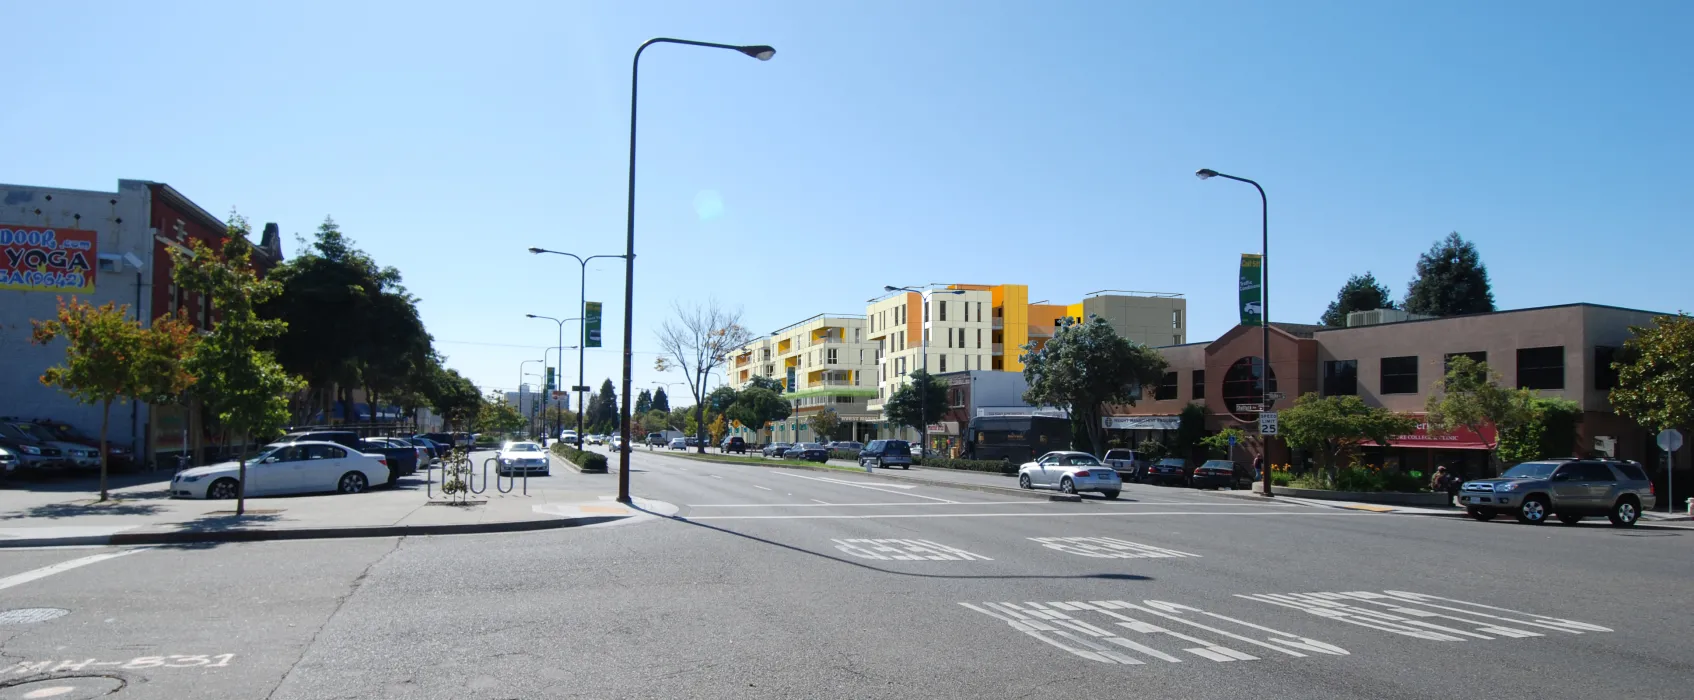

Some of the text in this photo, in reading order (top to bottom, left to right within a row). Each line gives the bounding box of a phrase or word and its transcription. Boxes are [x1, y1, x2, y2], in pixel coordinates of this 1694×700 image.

[5, 248, 91, 271] YOGA
[1261, 424, 1276, 433] 25
[830, 538, 995, 561] KEEP
[1026, 536, 1204, 559] KEEP
[1232, 590, 1615, 642] CLEAR
[957, 600, 1351, 664] CLEAR
[0, 653, 235, 674] MH-831
